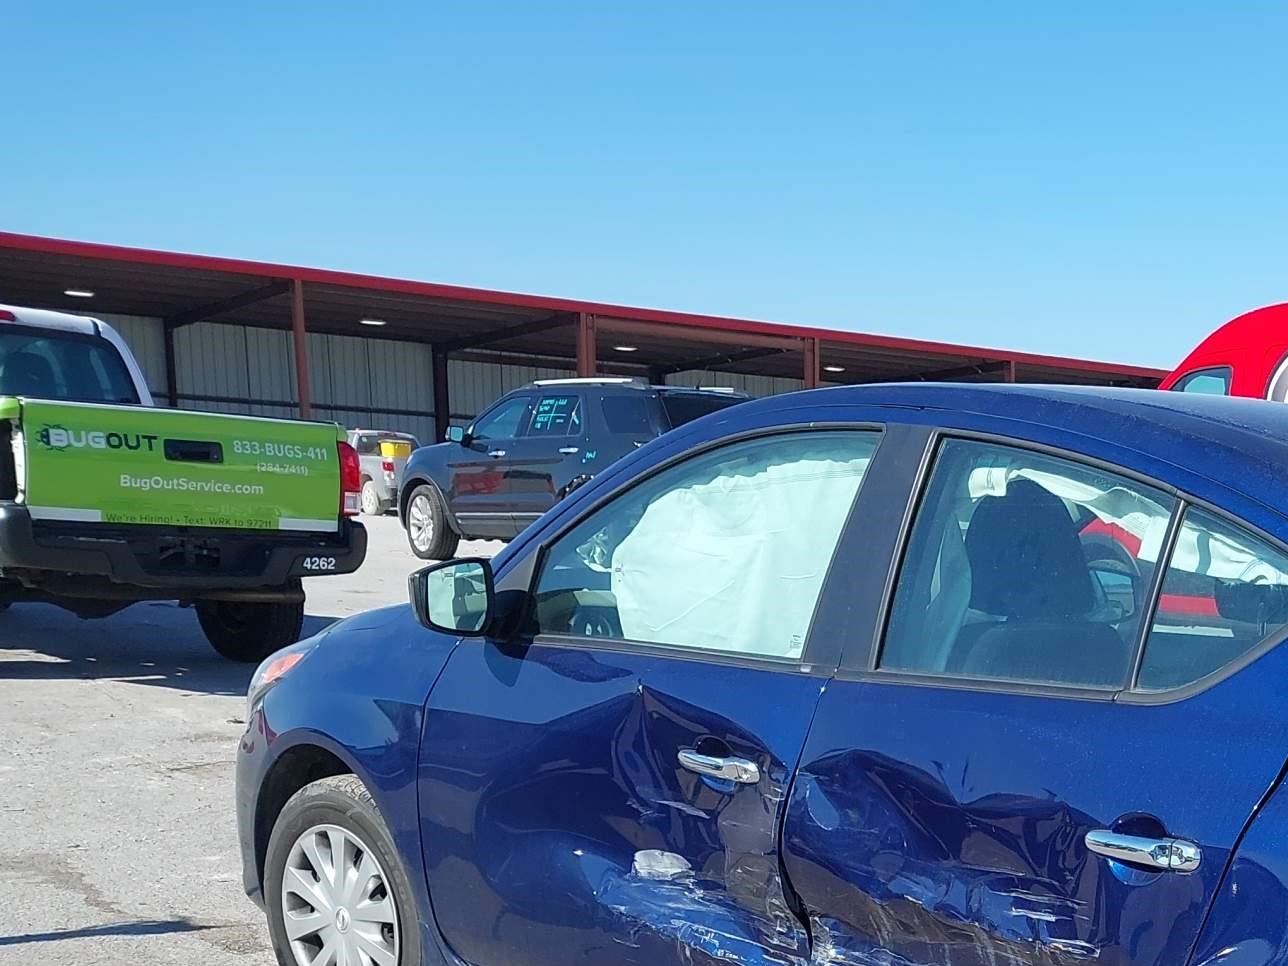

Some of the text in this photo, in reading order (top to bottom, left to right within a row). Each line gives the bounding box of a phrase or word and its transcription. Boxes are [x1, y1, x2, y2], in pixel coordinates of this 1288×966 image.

[48, 428, 327, 461] BUGOUT 833-BUGS-411
[120, 475, 264, 495] BugOutService.com
[303, 557, 336, 570] 4262
